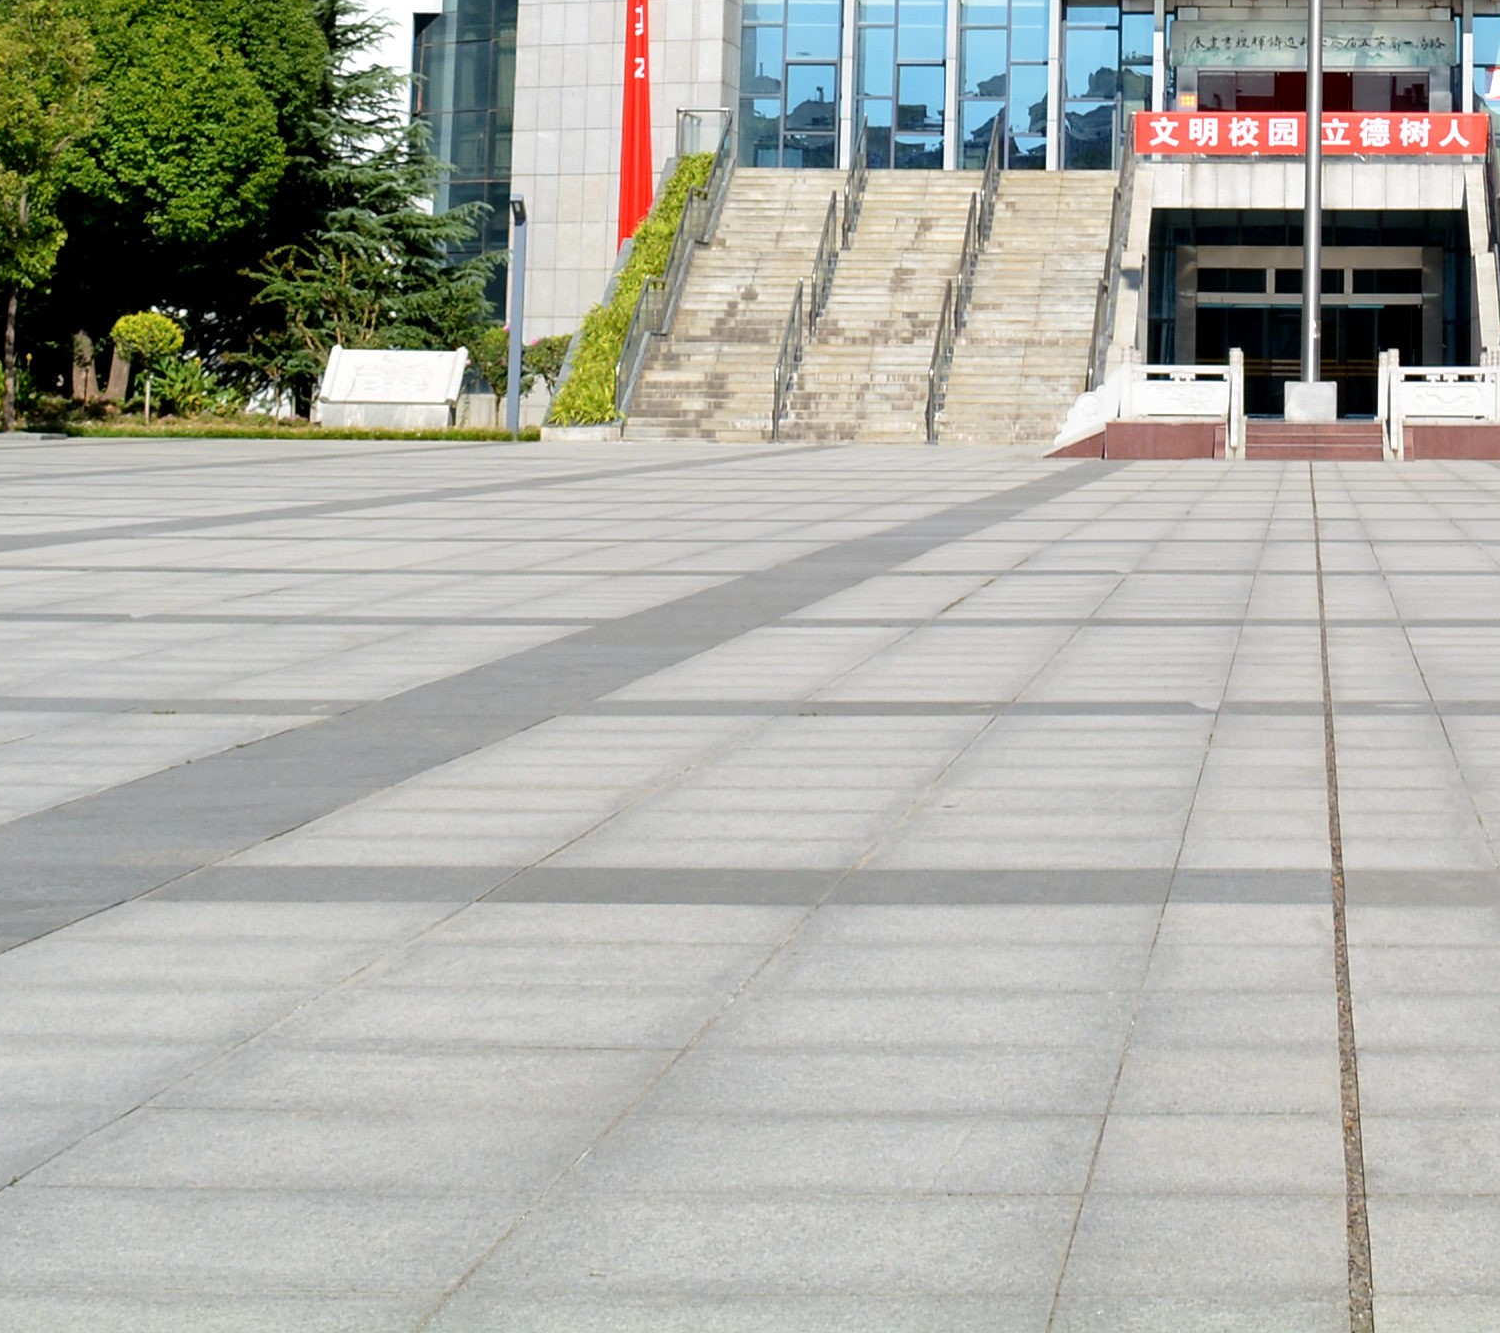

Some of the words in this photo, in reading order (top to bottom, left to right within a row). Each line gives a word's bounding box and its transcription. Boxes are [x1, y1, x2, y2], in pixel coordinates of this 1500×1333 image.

[1149, 117, 1299, 148] 文明校园
[1321, 117, 1470, 148] 立德树人
